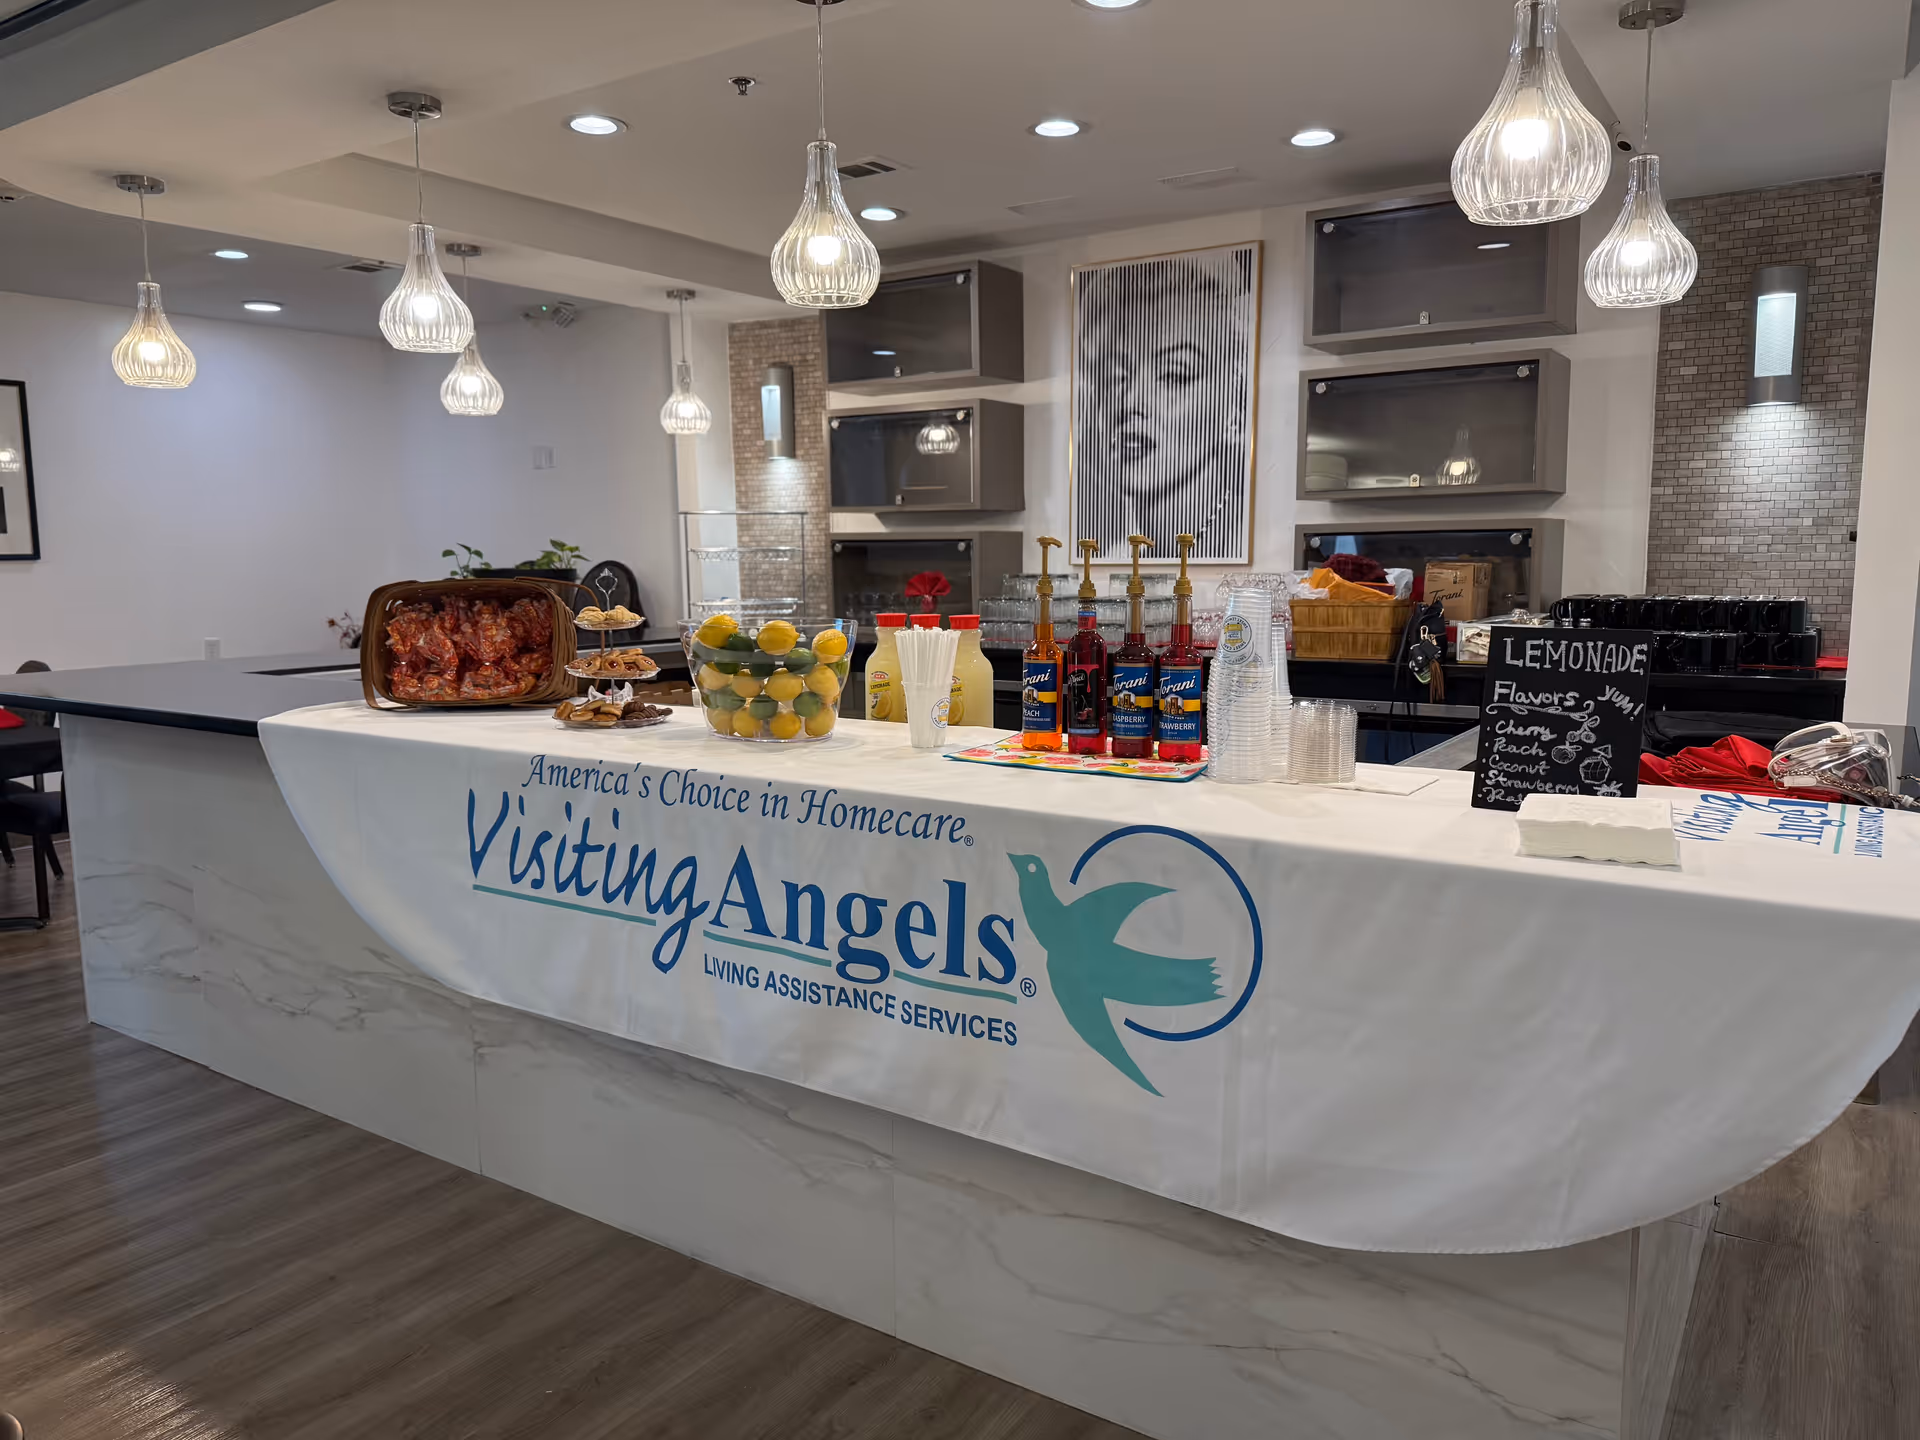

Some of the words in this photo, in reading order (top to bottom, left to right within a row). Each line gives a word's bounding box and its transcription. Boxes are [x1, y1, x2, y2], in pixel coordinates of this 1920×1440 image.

[1429, 588, 1464, 604] Torani
[1503, 637, 1648, 676] LEMONADE
[1112, 672, 1149, 691] Torani
[1159, 675, 1197, 698] Torani
[1493, 680, 1580, 708] Flavors
[1159, 721, 1197, 731] TRAWBERRY
[1495, 719, 1557, 742] Cherry
[1493, 737, 1548, 758] Peach
[1488, 754, 1551, 776] Coconut
[521, 753, 651, 800] America's
[659, 769, 750, 815] Choice
[760, 781, 789, 821] in
[1755, 798, 1847, 846] Angel
[1856, 806, 1885, 840] ASSISTANC
[467, 787, 711, 975] Visiting
[704, 953, 761, 990] LIVING
[763, 969, 898, 1021] ASSISTANCE
[900, 1000, 1018, 1048] SERVICES
